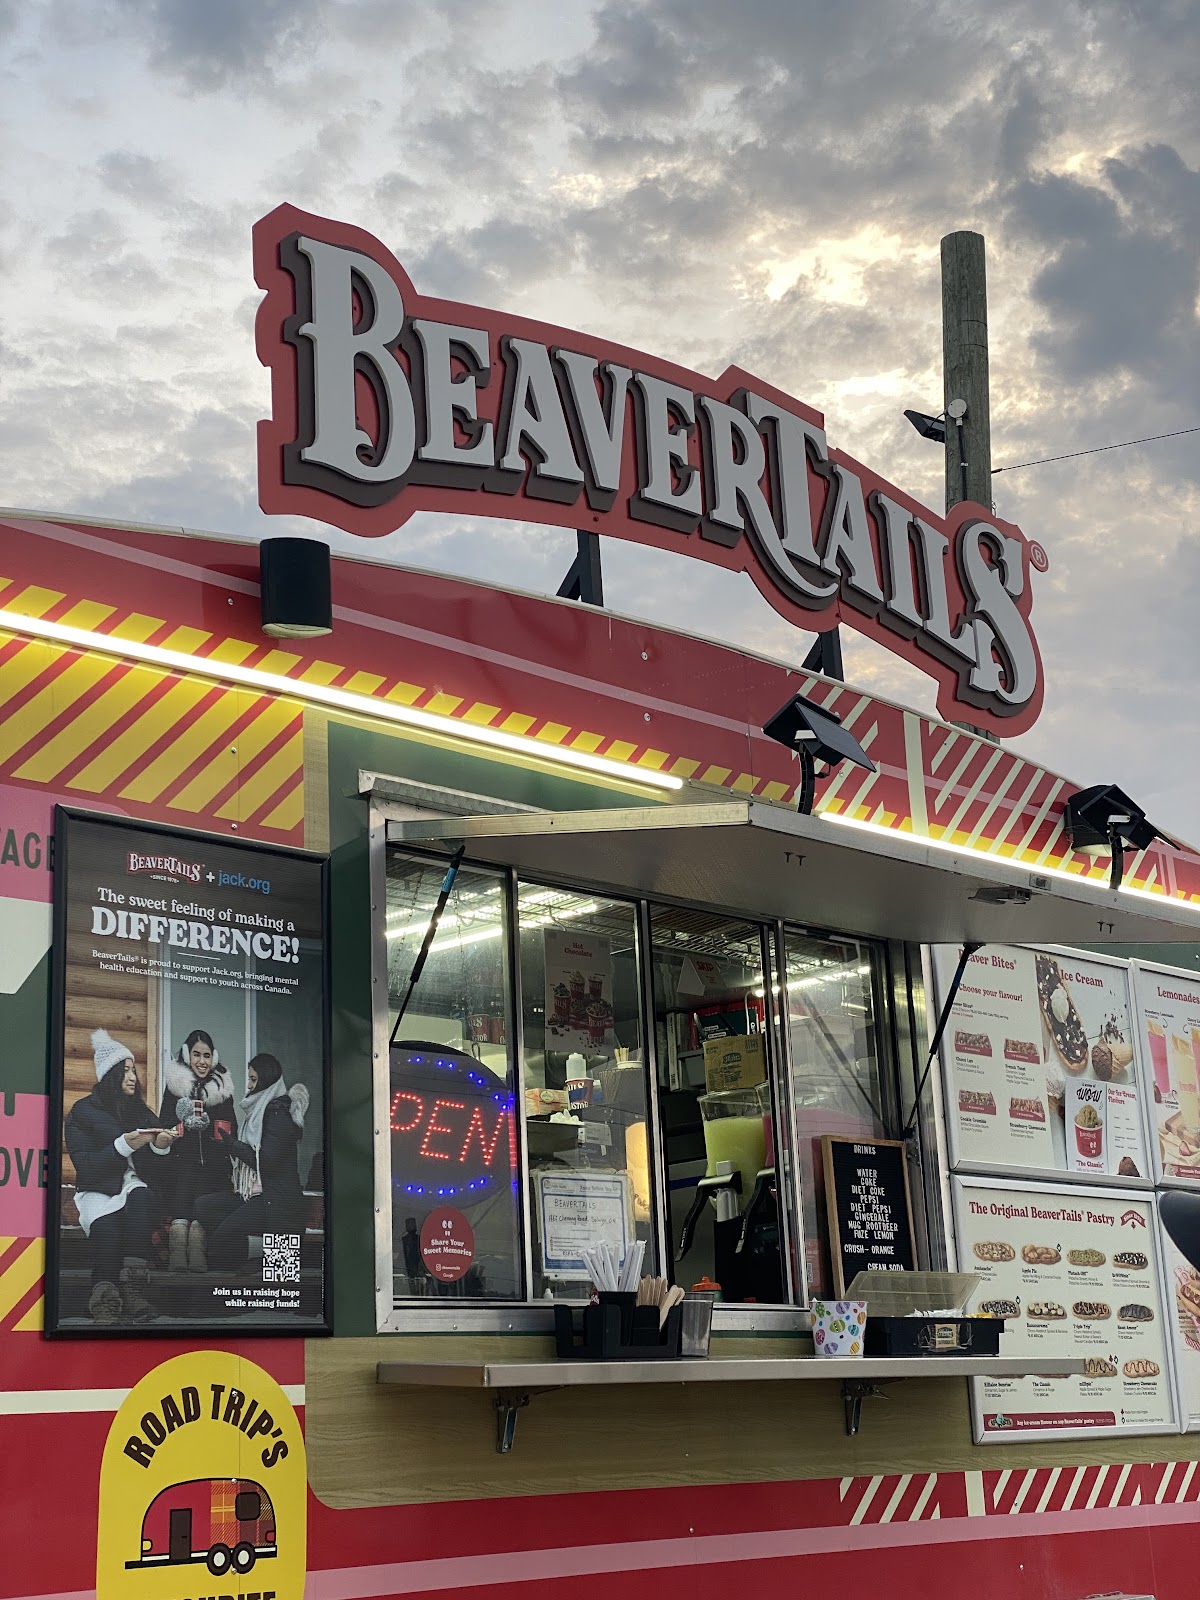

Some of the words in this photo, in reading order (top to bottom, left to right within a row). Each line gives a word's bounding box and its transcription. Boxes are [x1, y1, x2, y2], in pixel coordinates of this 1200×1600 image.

[284, 233, 1038, 705] BEAVERTAILS
[218, 870, 270, 894] jack.org
[98, 887, 124, 904] The
[129, 896, 167, 911] sweet
[171, 899, 215, 921] feeling
[218, 908, 232, 921] of
[234, 913, 284, 932] making
[287, 922, 295, 932] a
[91, 906, 300, 964] DIFFERENCE!
[564, 948, 592, 957] Chocolate
[100, 962, 125, 972] health
[126, 966, 162, 977] education
[180, 974, 208, 984] support
[219, 978, 239, 988] youth
[241, 982, 263, 990] across
[265, 984, 292, 995] Canada.
[149, 959, 171, 967] proud
[182, 963, 210, 973] support
[245, 971, 274, 983] bringing
[275, 977, 299, 986] mental
[1061, 969, 1073, 982] Ice
[1075, 972, 1104, 988] Cream
[959, 983, 982, 995] Choose
[983, 988, 997, 997] your
[999, 990, 1023, 1002] flavour!
[1157, 986, 1200, 1005] Lemonades
[854, 1144, 877, 1155] DRINKS
[857, 1168, 878, 1178] WATER
[860, 1178, 877, 1187] COKE
[851, 1184, 866, 1195] DIET
[869, 1187, 886, 1197] COKE
[860, 1195, 879, 1204] PEPSI
[850, 1202, 866, 1212] DIET
[872, 1204, 892, 1214] PEPSI
[970, 1202, 988, 1214] The
[990, 1203, 1029, 1219] Original
[1087, 1211, 1115, 1226] Pastry
[874, 1230, 895, 1240] LEMON
[450, 1239, 465, 1247] Your
[423, 1247, 442, 1255] Sweet
[443, 1247, 472, 1257] Memories
[871, 1245, 895, 1255] ORANGE
[889, 1263, 905, 1271] SODA
[213, 1287, 231, 1296] Join
[243, 1287, 252, 1296] in
[253, 1288, 280, 1298] raising
[281, 1288, 300, 1298] hope
[225, 1299, 246, 1307] while
[248, 1300, 275, 1308] raising
[276, 1300, 300, 1308] funds!
[123, 1386, 201, 1469] ROAD
[210, 1383, 289, 1469] TRIP'S
